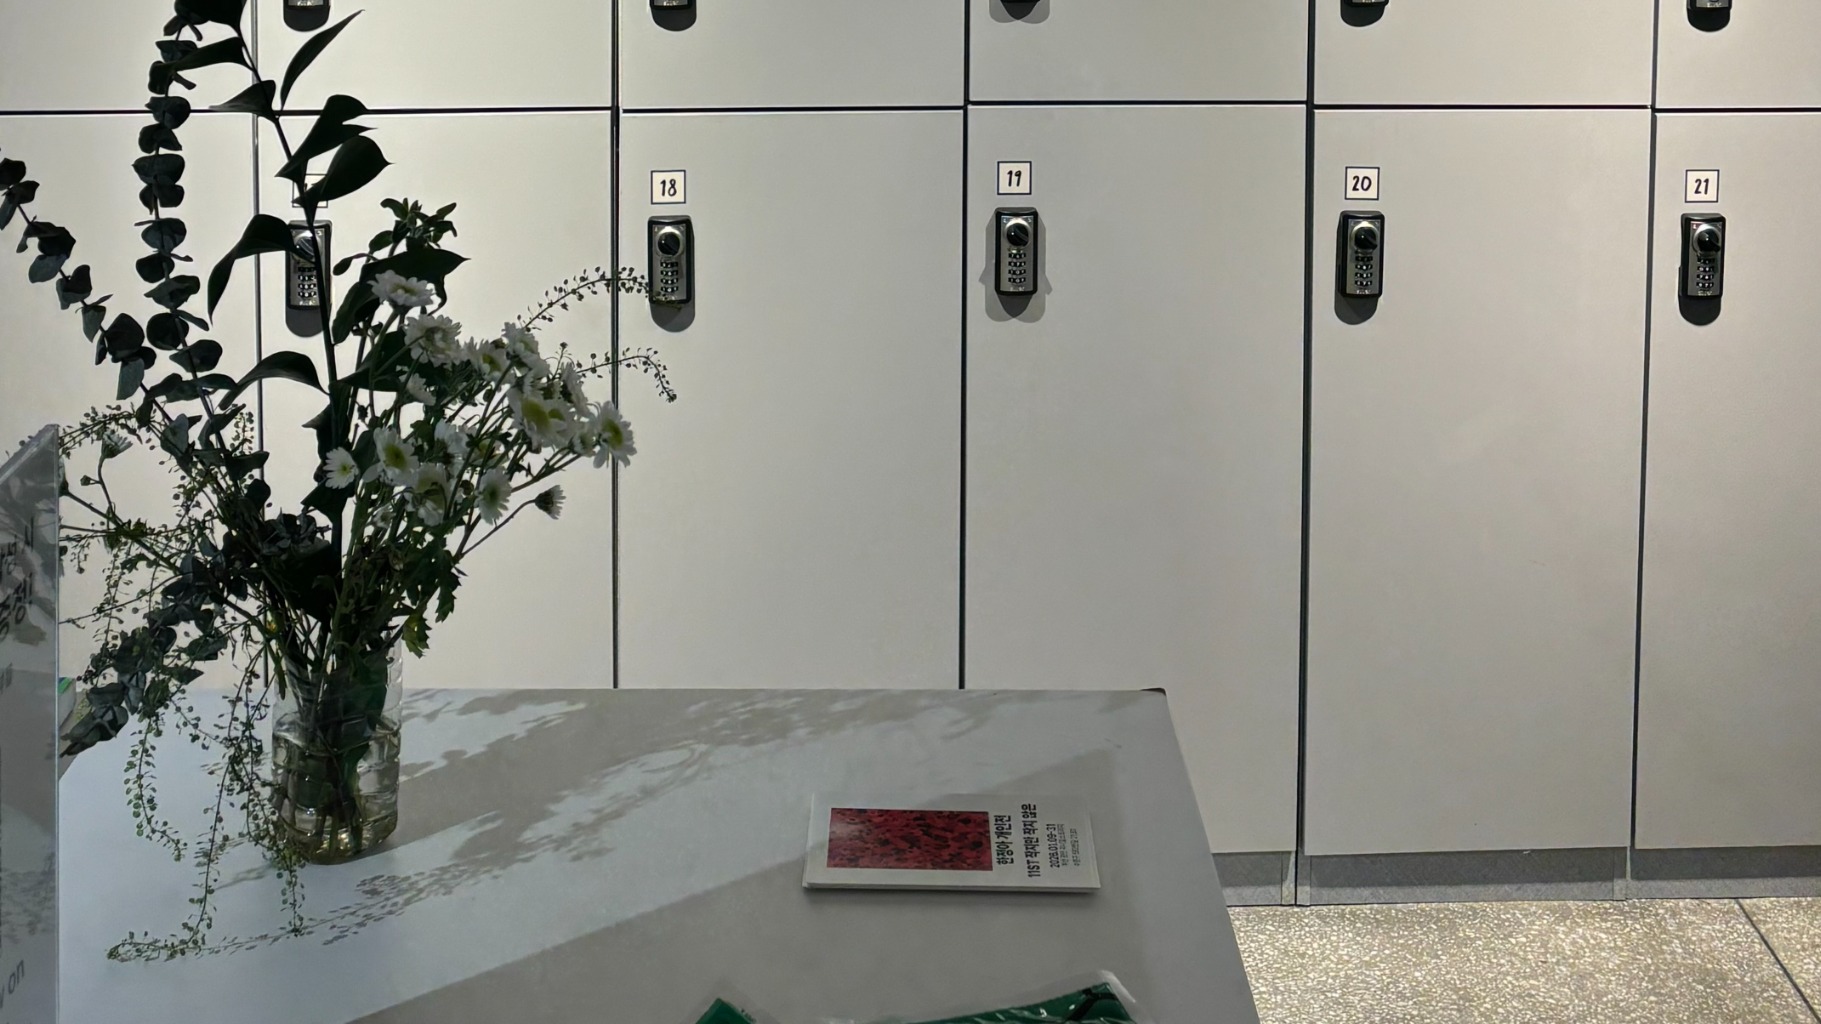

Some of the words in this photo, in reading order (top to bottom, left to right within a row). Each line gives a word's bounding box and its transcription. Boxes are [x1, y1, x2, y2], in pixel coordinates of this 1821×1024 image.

[659, 178, 678, 198] 18
[1006, 169, 1023, 188] 19
[1351, 175, 1373, 192] 20
[1693, 177, 1710, 196] 21
[993, 814, 1013, 840] 개인전
[1021, 820, 1039, 836] 작지
[995, 841, 1015, 865] 한정아
[1023, 836, 1041, 859] 작지만
